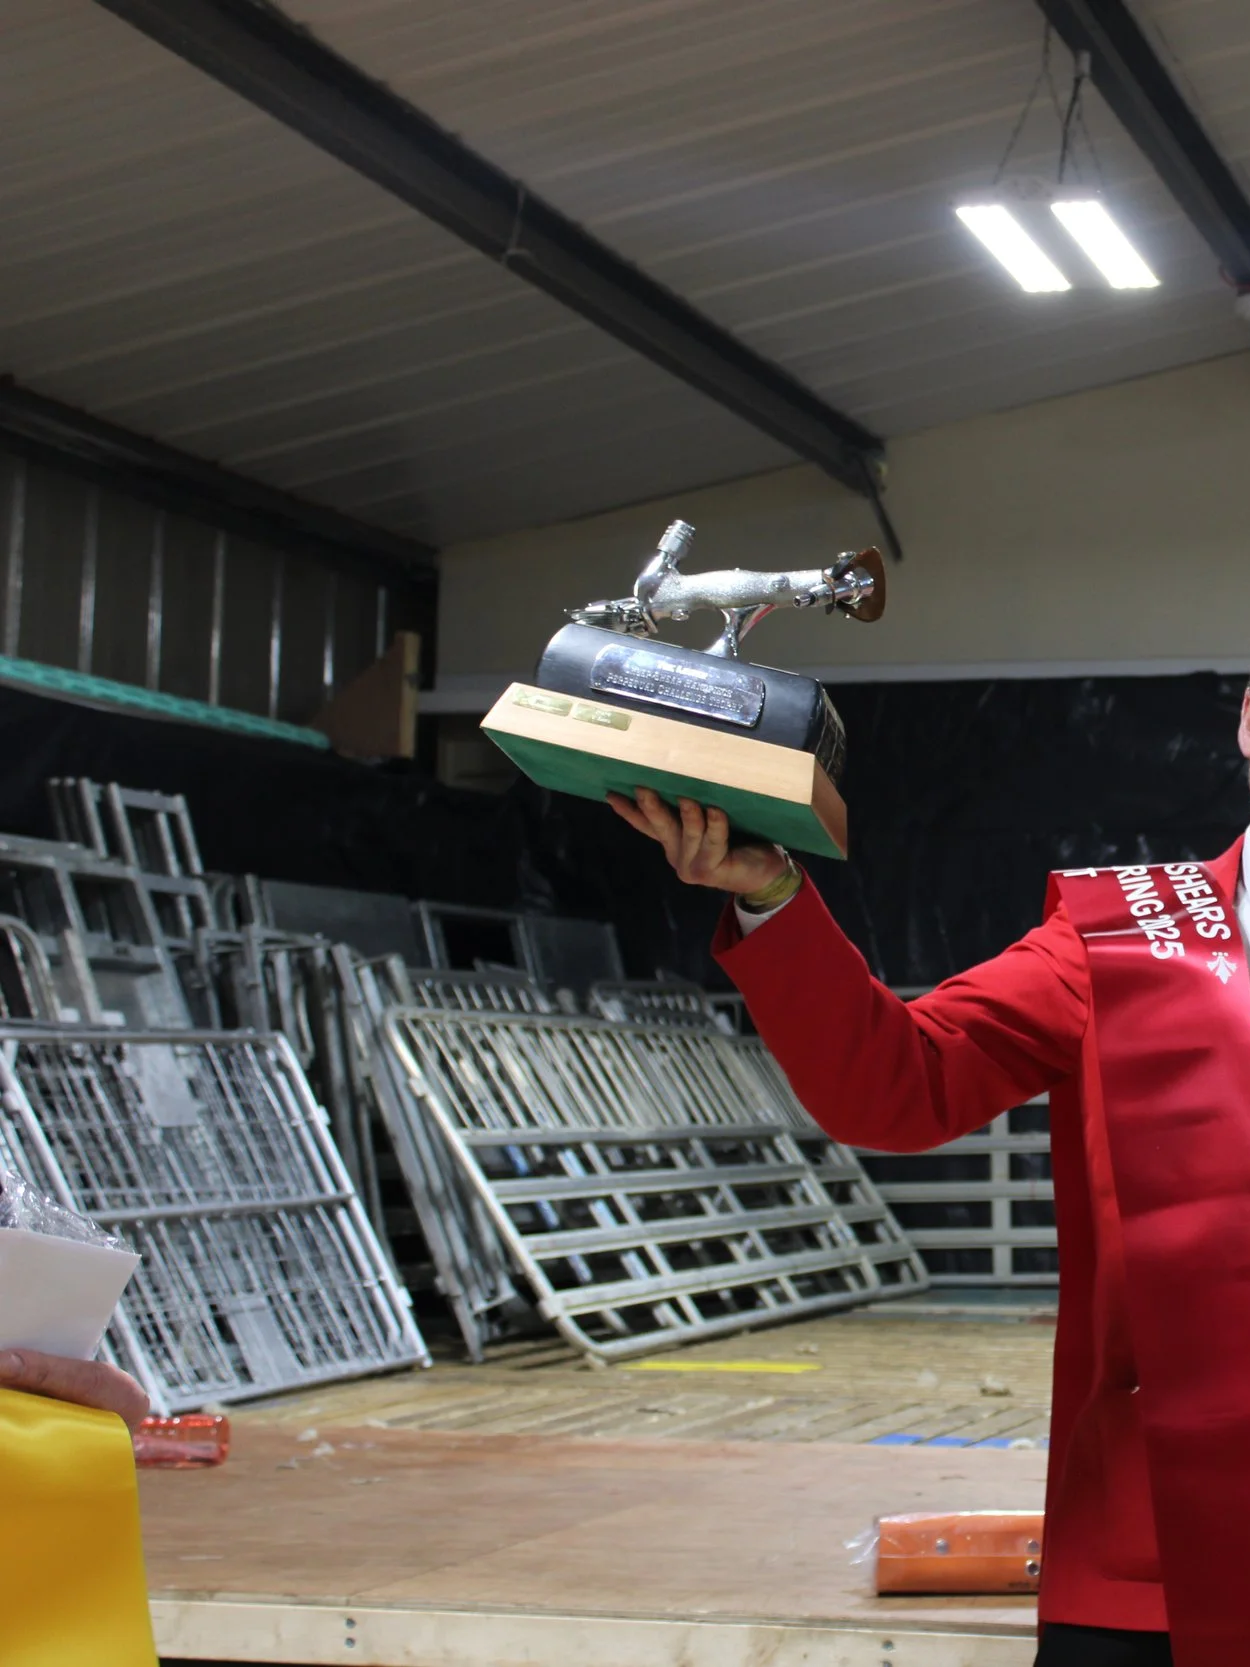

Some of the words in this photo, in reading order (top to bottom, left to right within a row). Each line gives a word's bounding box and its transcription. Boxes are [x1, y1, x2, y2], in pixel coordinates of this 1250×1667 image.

[1112, 864, 1165, 917] RING
[1163, 863, 1232, 940] SHEARS
[1136, 914, 1186, 960] 2025
